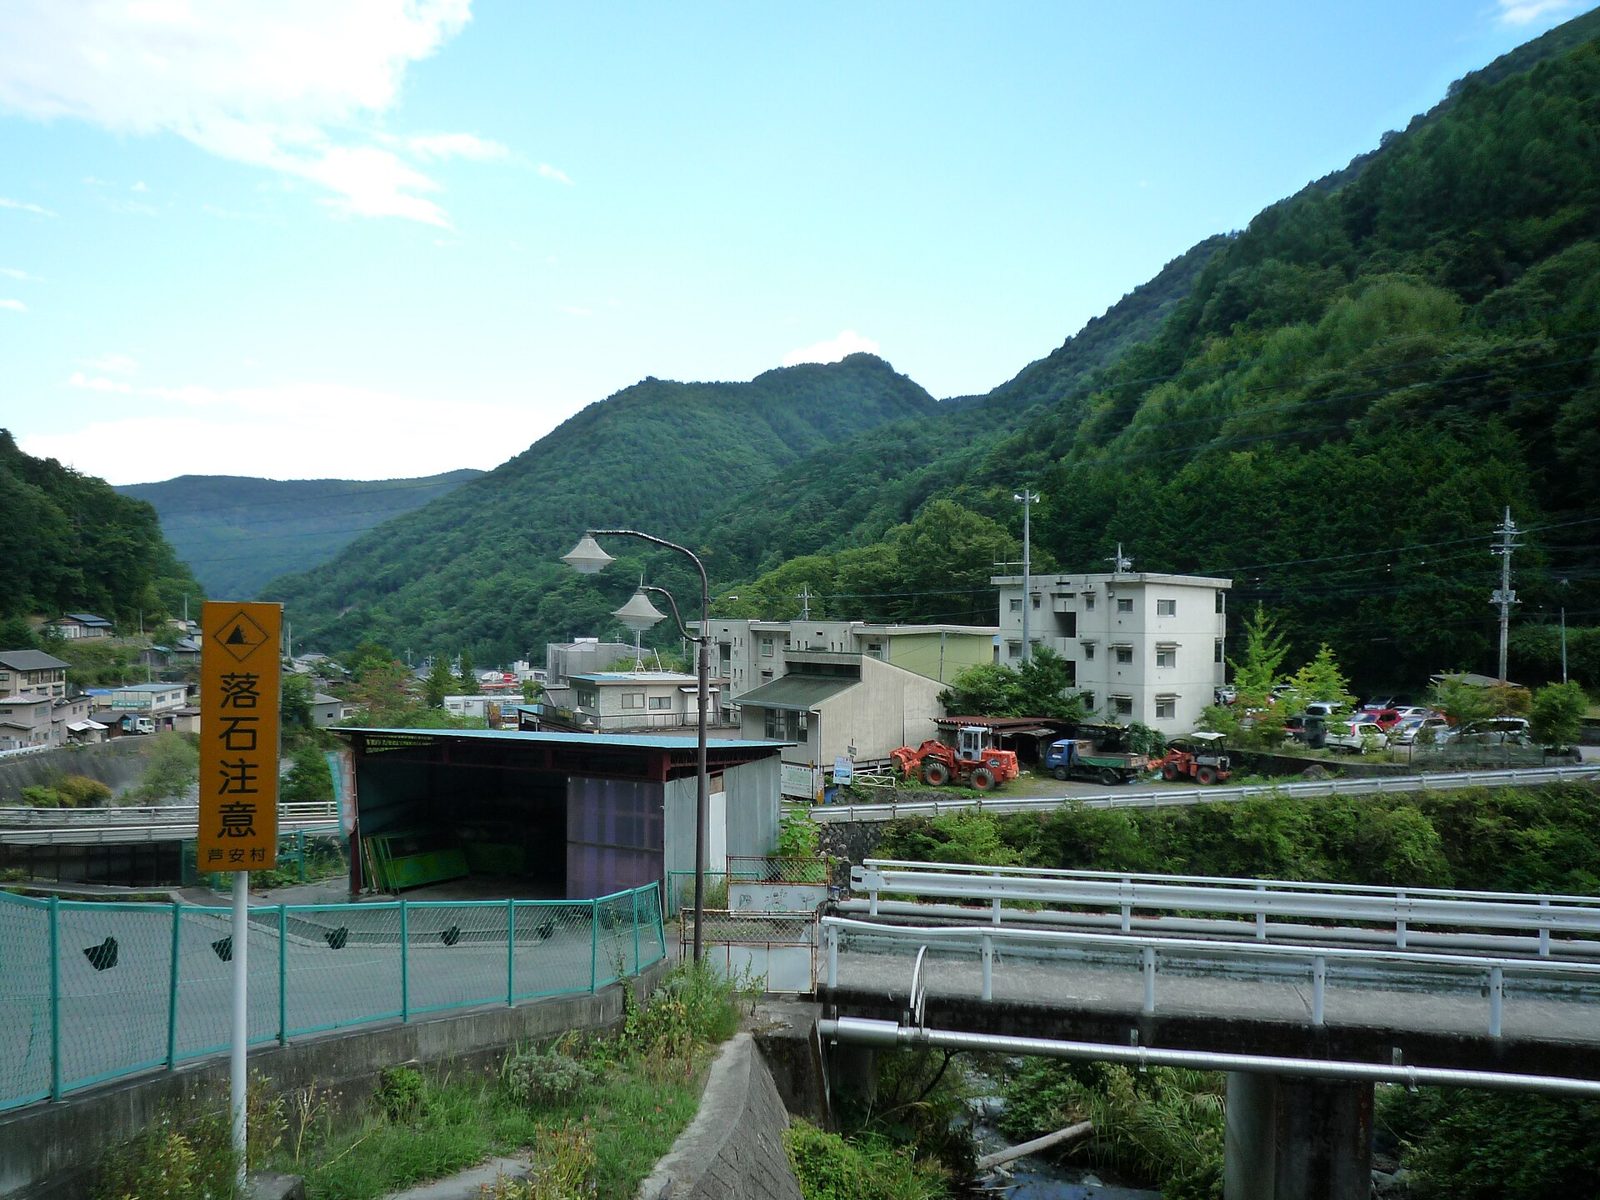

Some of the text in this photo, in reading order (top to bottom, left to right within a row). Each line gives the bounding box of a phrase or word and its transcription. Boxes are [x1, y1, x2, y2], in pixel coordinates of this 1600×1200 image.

[217, 672, 260, 839] 落石注意
[208, 847, 265, 863] 芦安村
